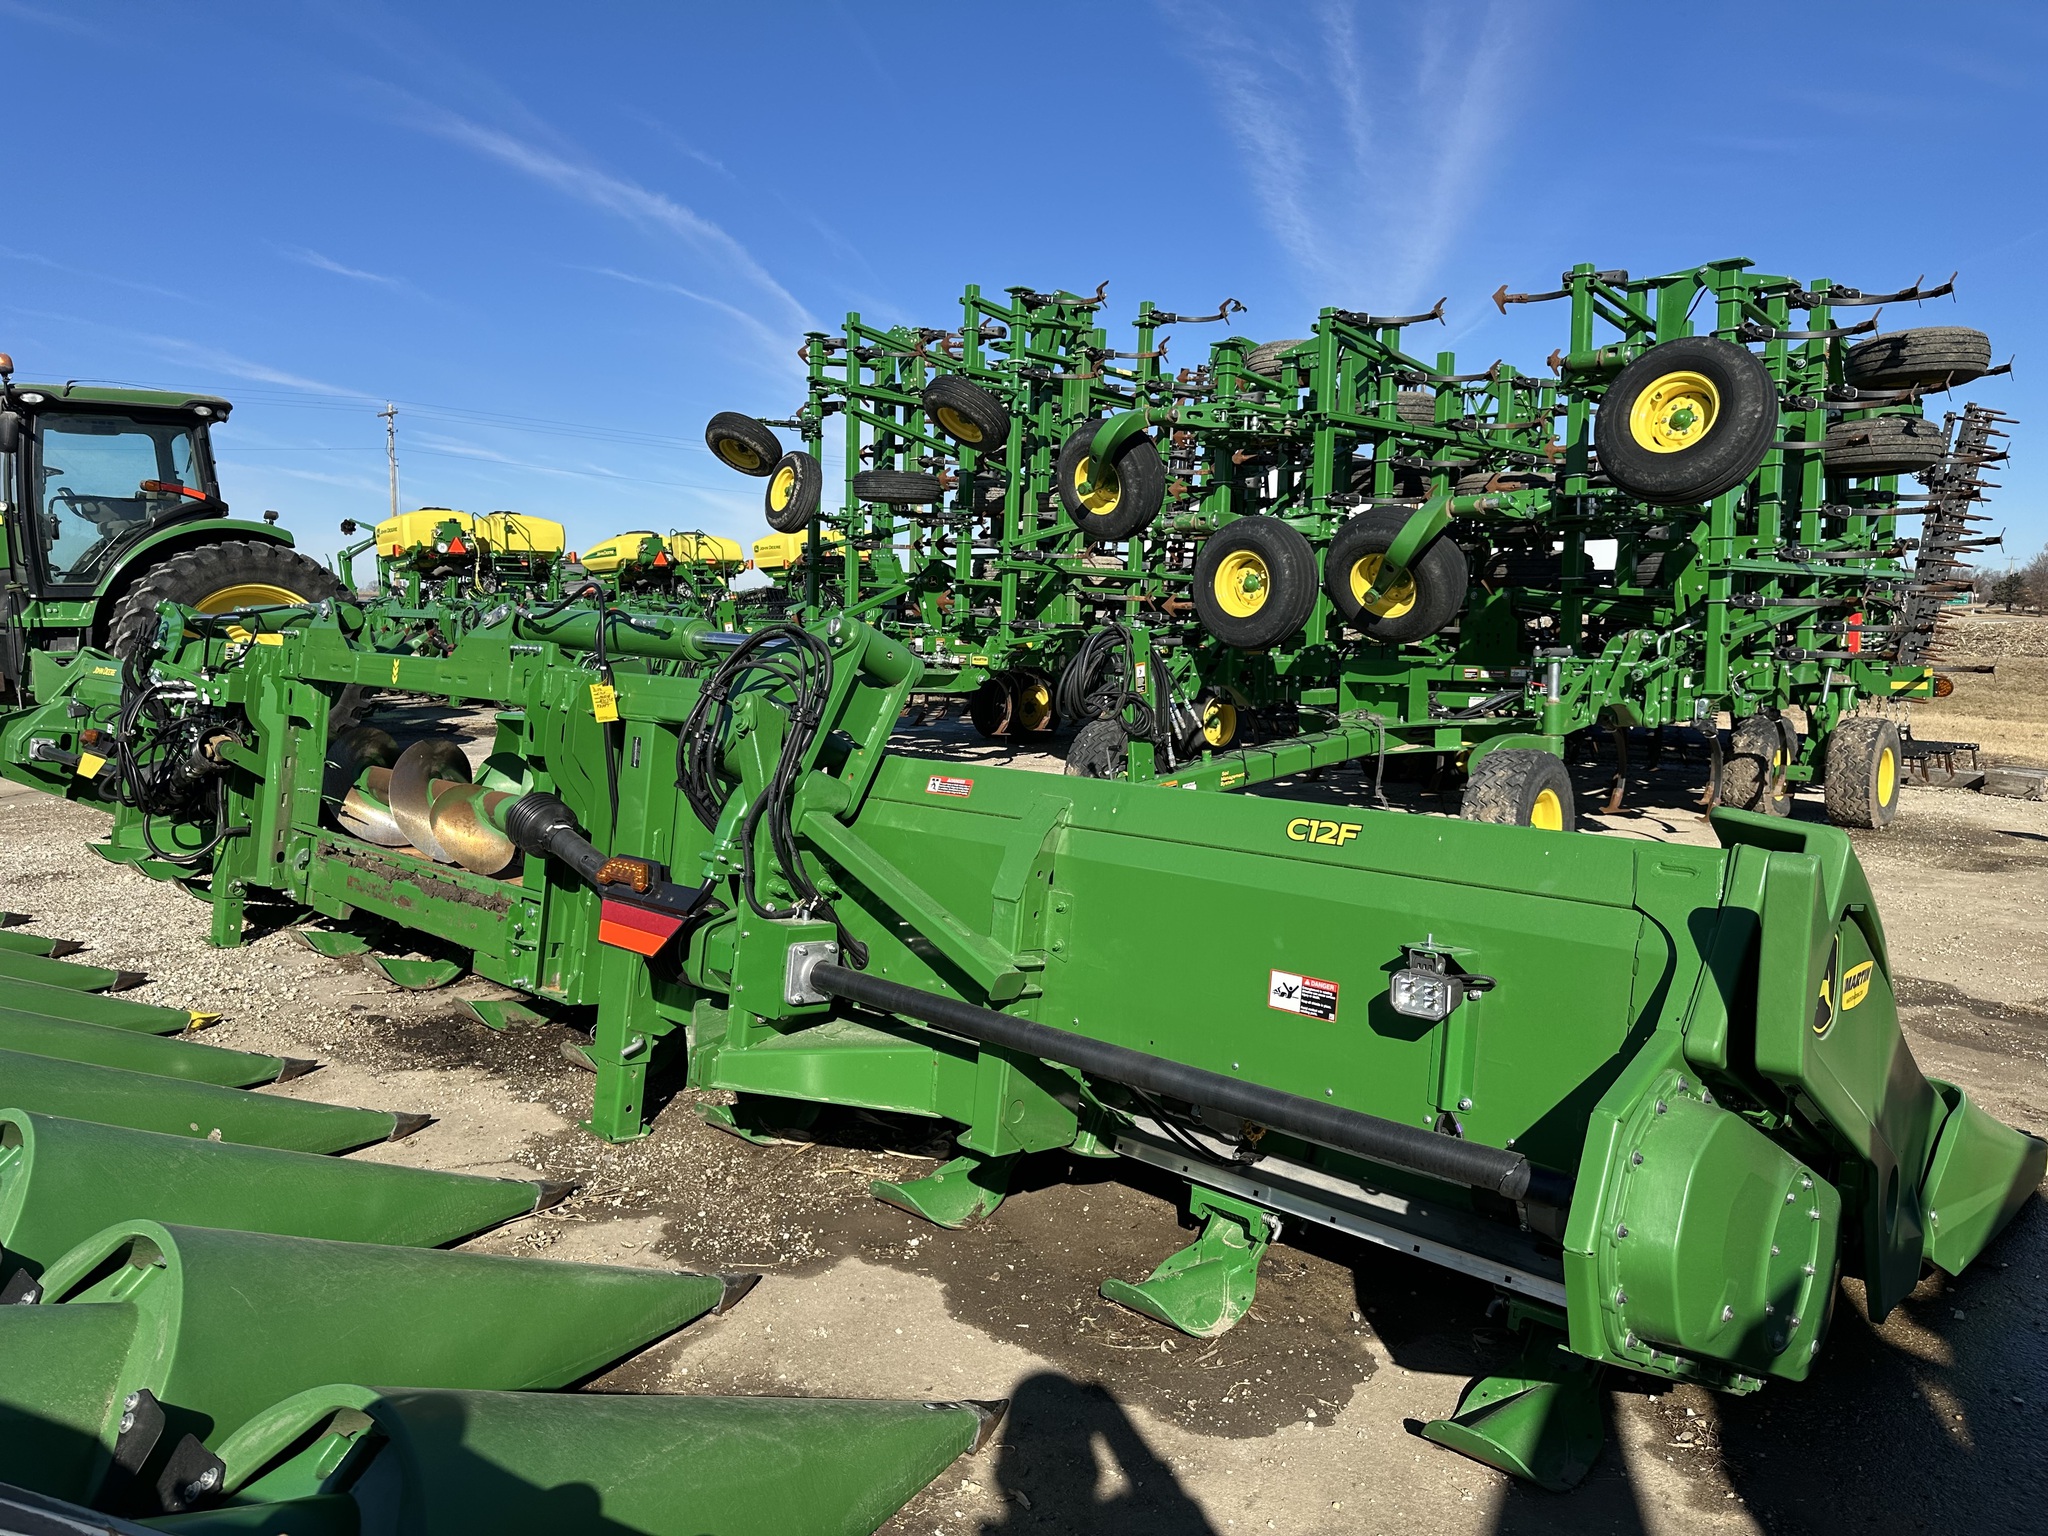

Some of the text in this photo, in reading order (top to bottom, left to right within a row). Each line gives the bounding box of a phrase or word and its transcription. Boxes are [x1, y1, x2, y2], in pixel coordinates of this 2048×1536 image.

[1286, 817, 1363, 847] C12F
[1311, 980, 1335, 991] DANGER
[1844, 966, 1872, 994] MARTIN
